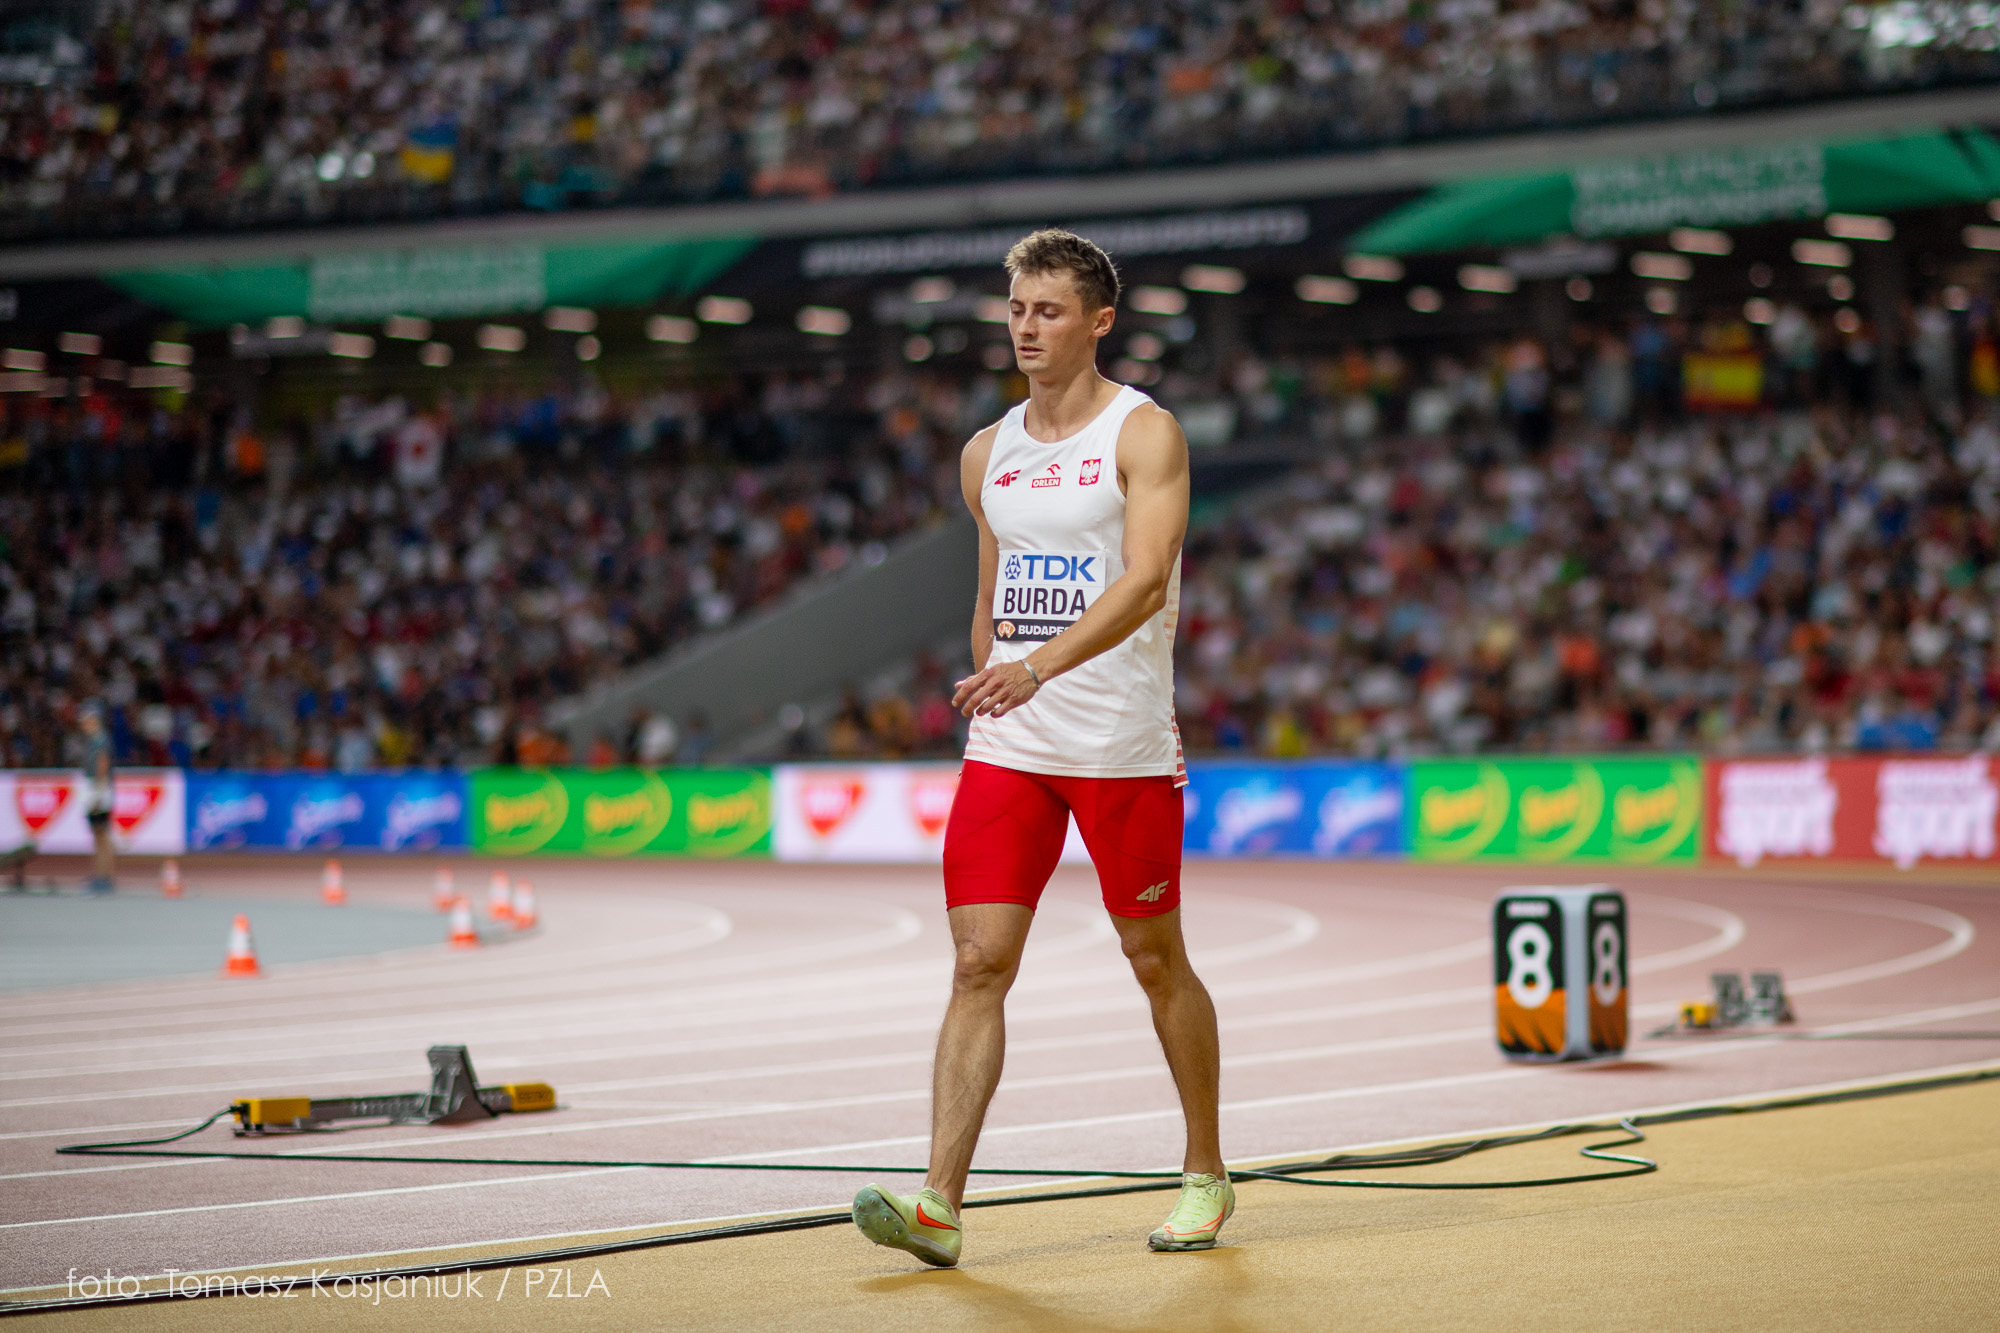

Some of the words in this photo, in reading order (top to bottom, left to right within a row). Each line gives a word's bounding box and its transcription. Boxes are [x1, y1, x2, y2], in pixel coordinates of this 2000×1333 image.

[1033, 478, 1060, 488] ORLEN
[1022, 555, 1096, 582] TDK
[1003, 587, 1088, 615] BURDA
[1018, 625, 1070, 636] BUDAPE
[1136, 880, 1169, 902] 4F
[1507, 922, 1553, 1009] 8
[1594, 922, 1621, 1006] 8
